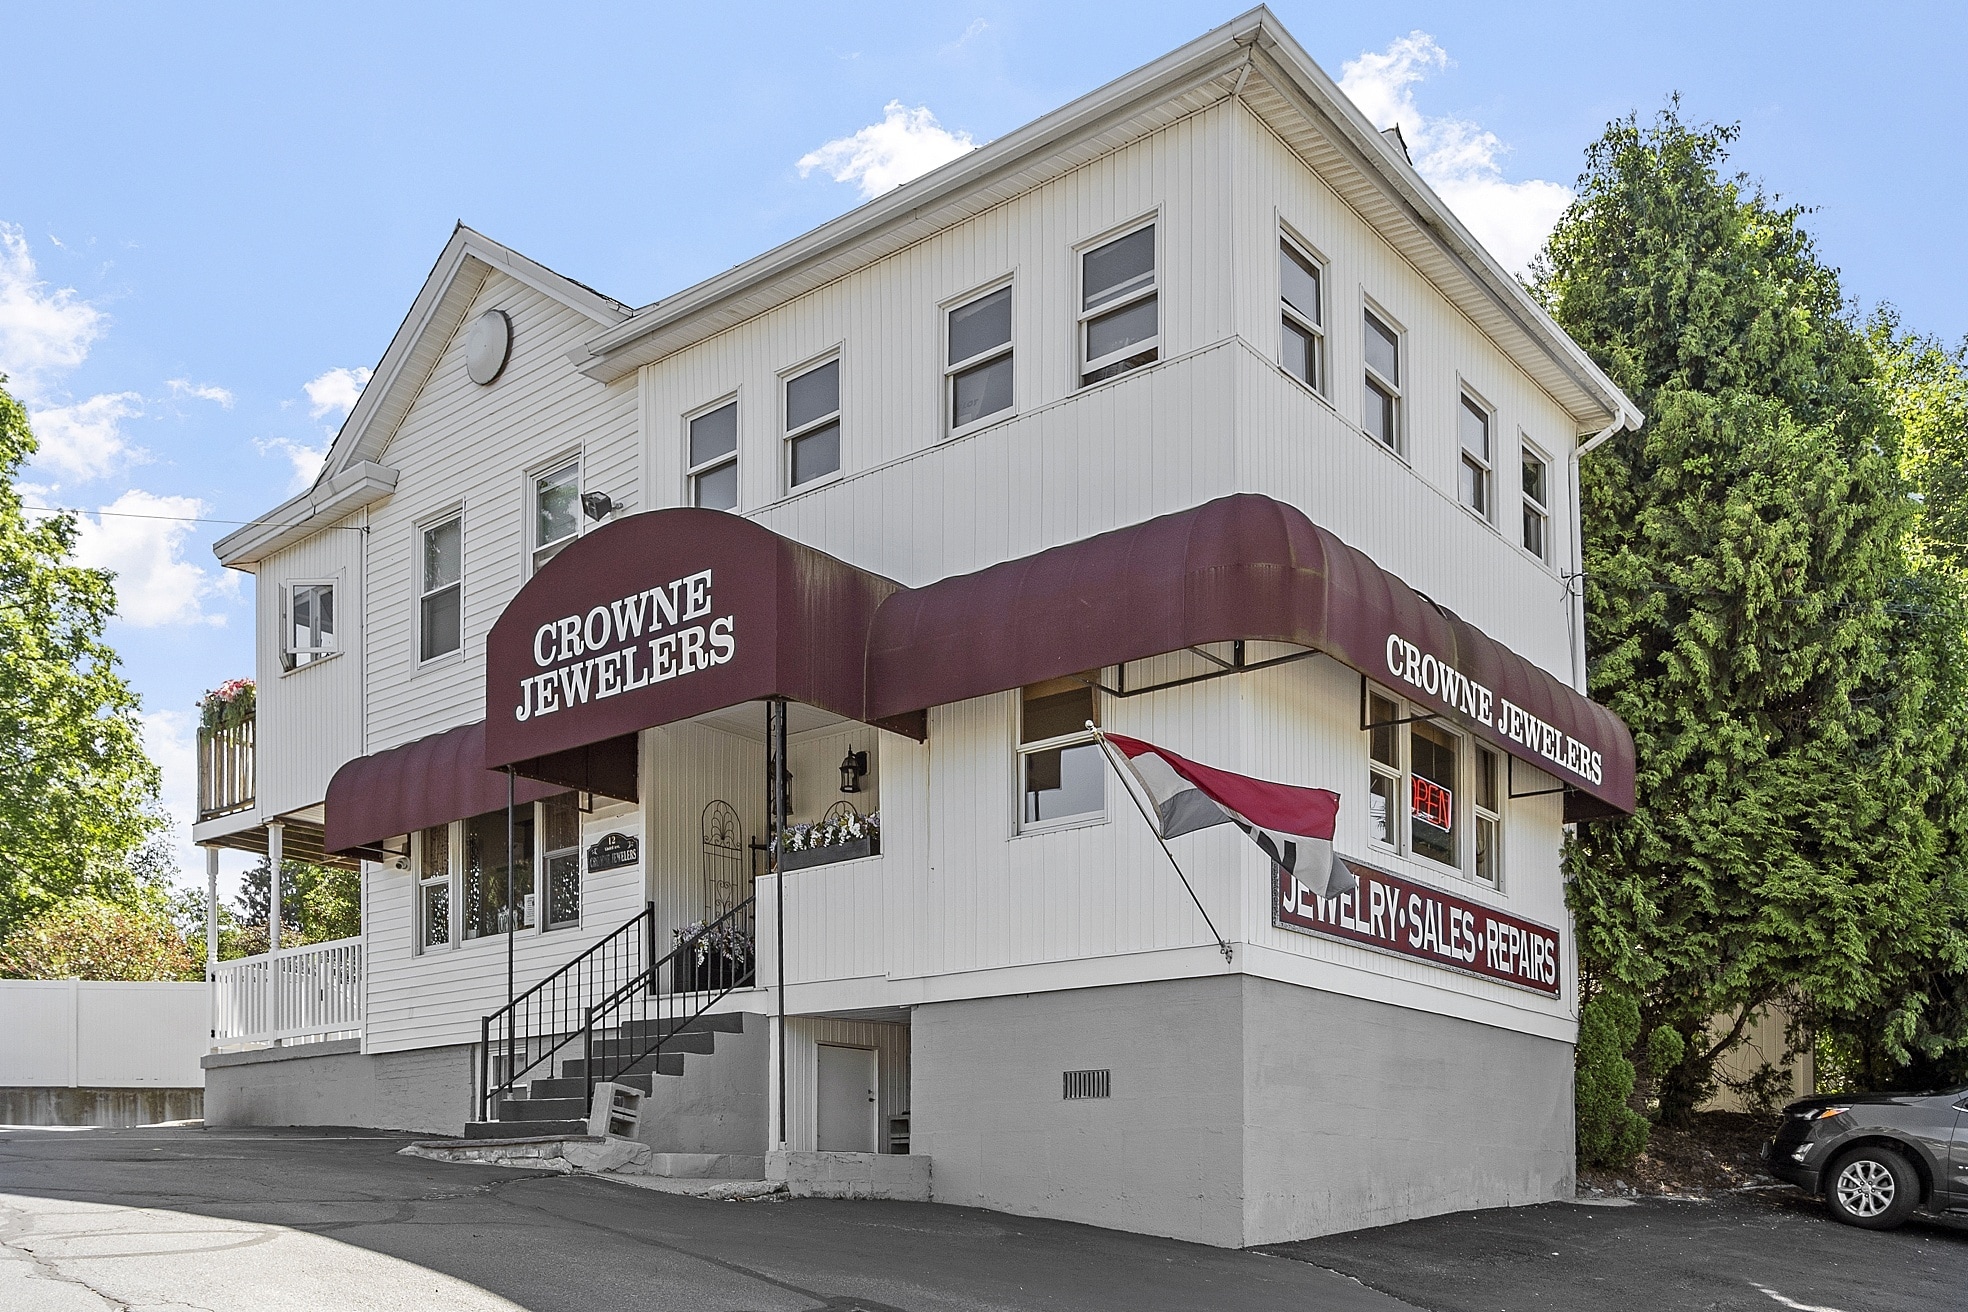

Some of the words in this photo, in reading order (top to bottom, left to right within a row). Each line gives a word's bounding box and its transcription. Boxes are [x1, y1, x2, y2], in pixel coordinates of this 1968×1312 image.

[533, 568, 712, 667] CROWNE
[515, 615, 735, 722] JEWELERS
[1386, 633, 1493, 728] CROWNE
[1498, 698, 1602, 786] JEWELERS
[608, 836, 616, 846] 12
[1408, 893, 1475, 963] SALES
[1486, 917, 1555, 985] REPAIRS
